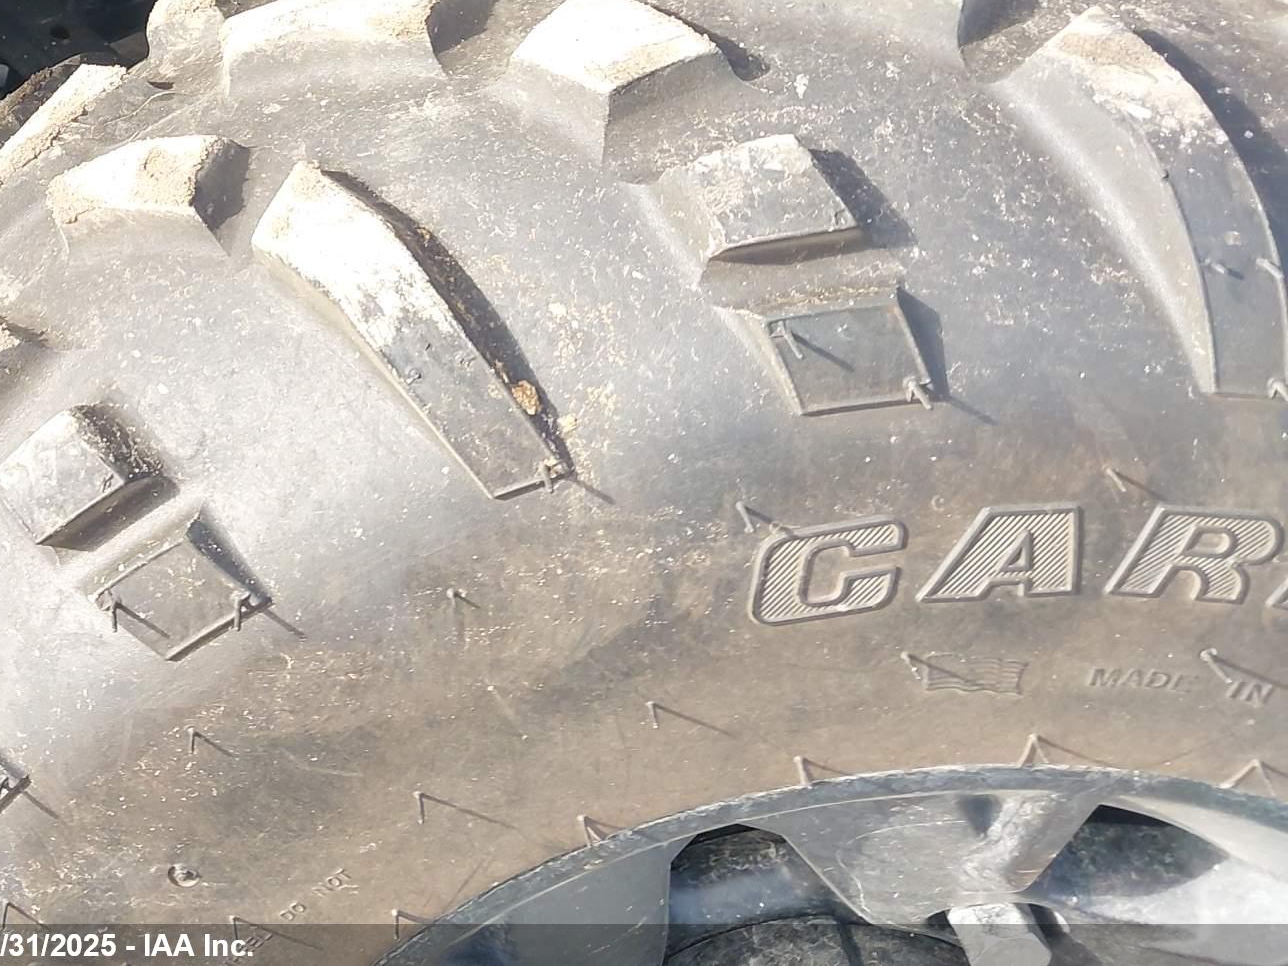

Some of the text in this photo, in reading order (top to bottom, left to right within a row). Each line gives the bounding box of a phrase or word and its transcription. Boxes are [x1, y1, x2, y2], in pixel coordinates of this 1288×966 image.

[748, 503, 1288, 626] CAR
[1088, 667, 1276, 708] MADE IN
